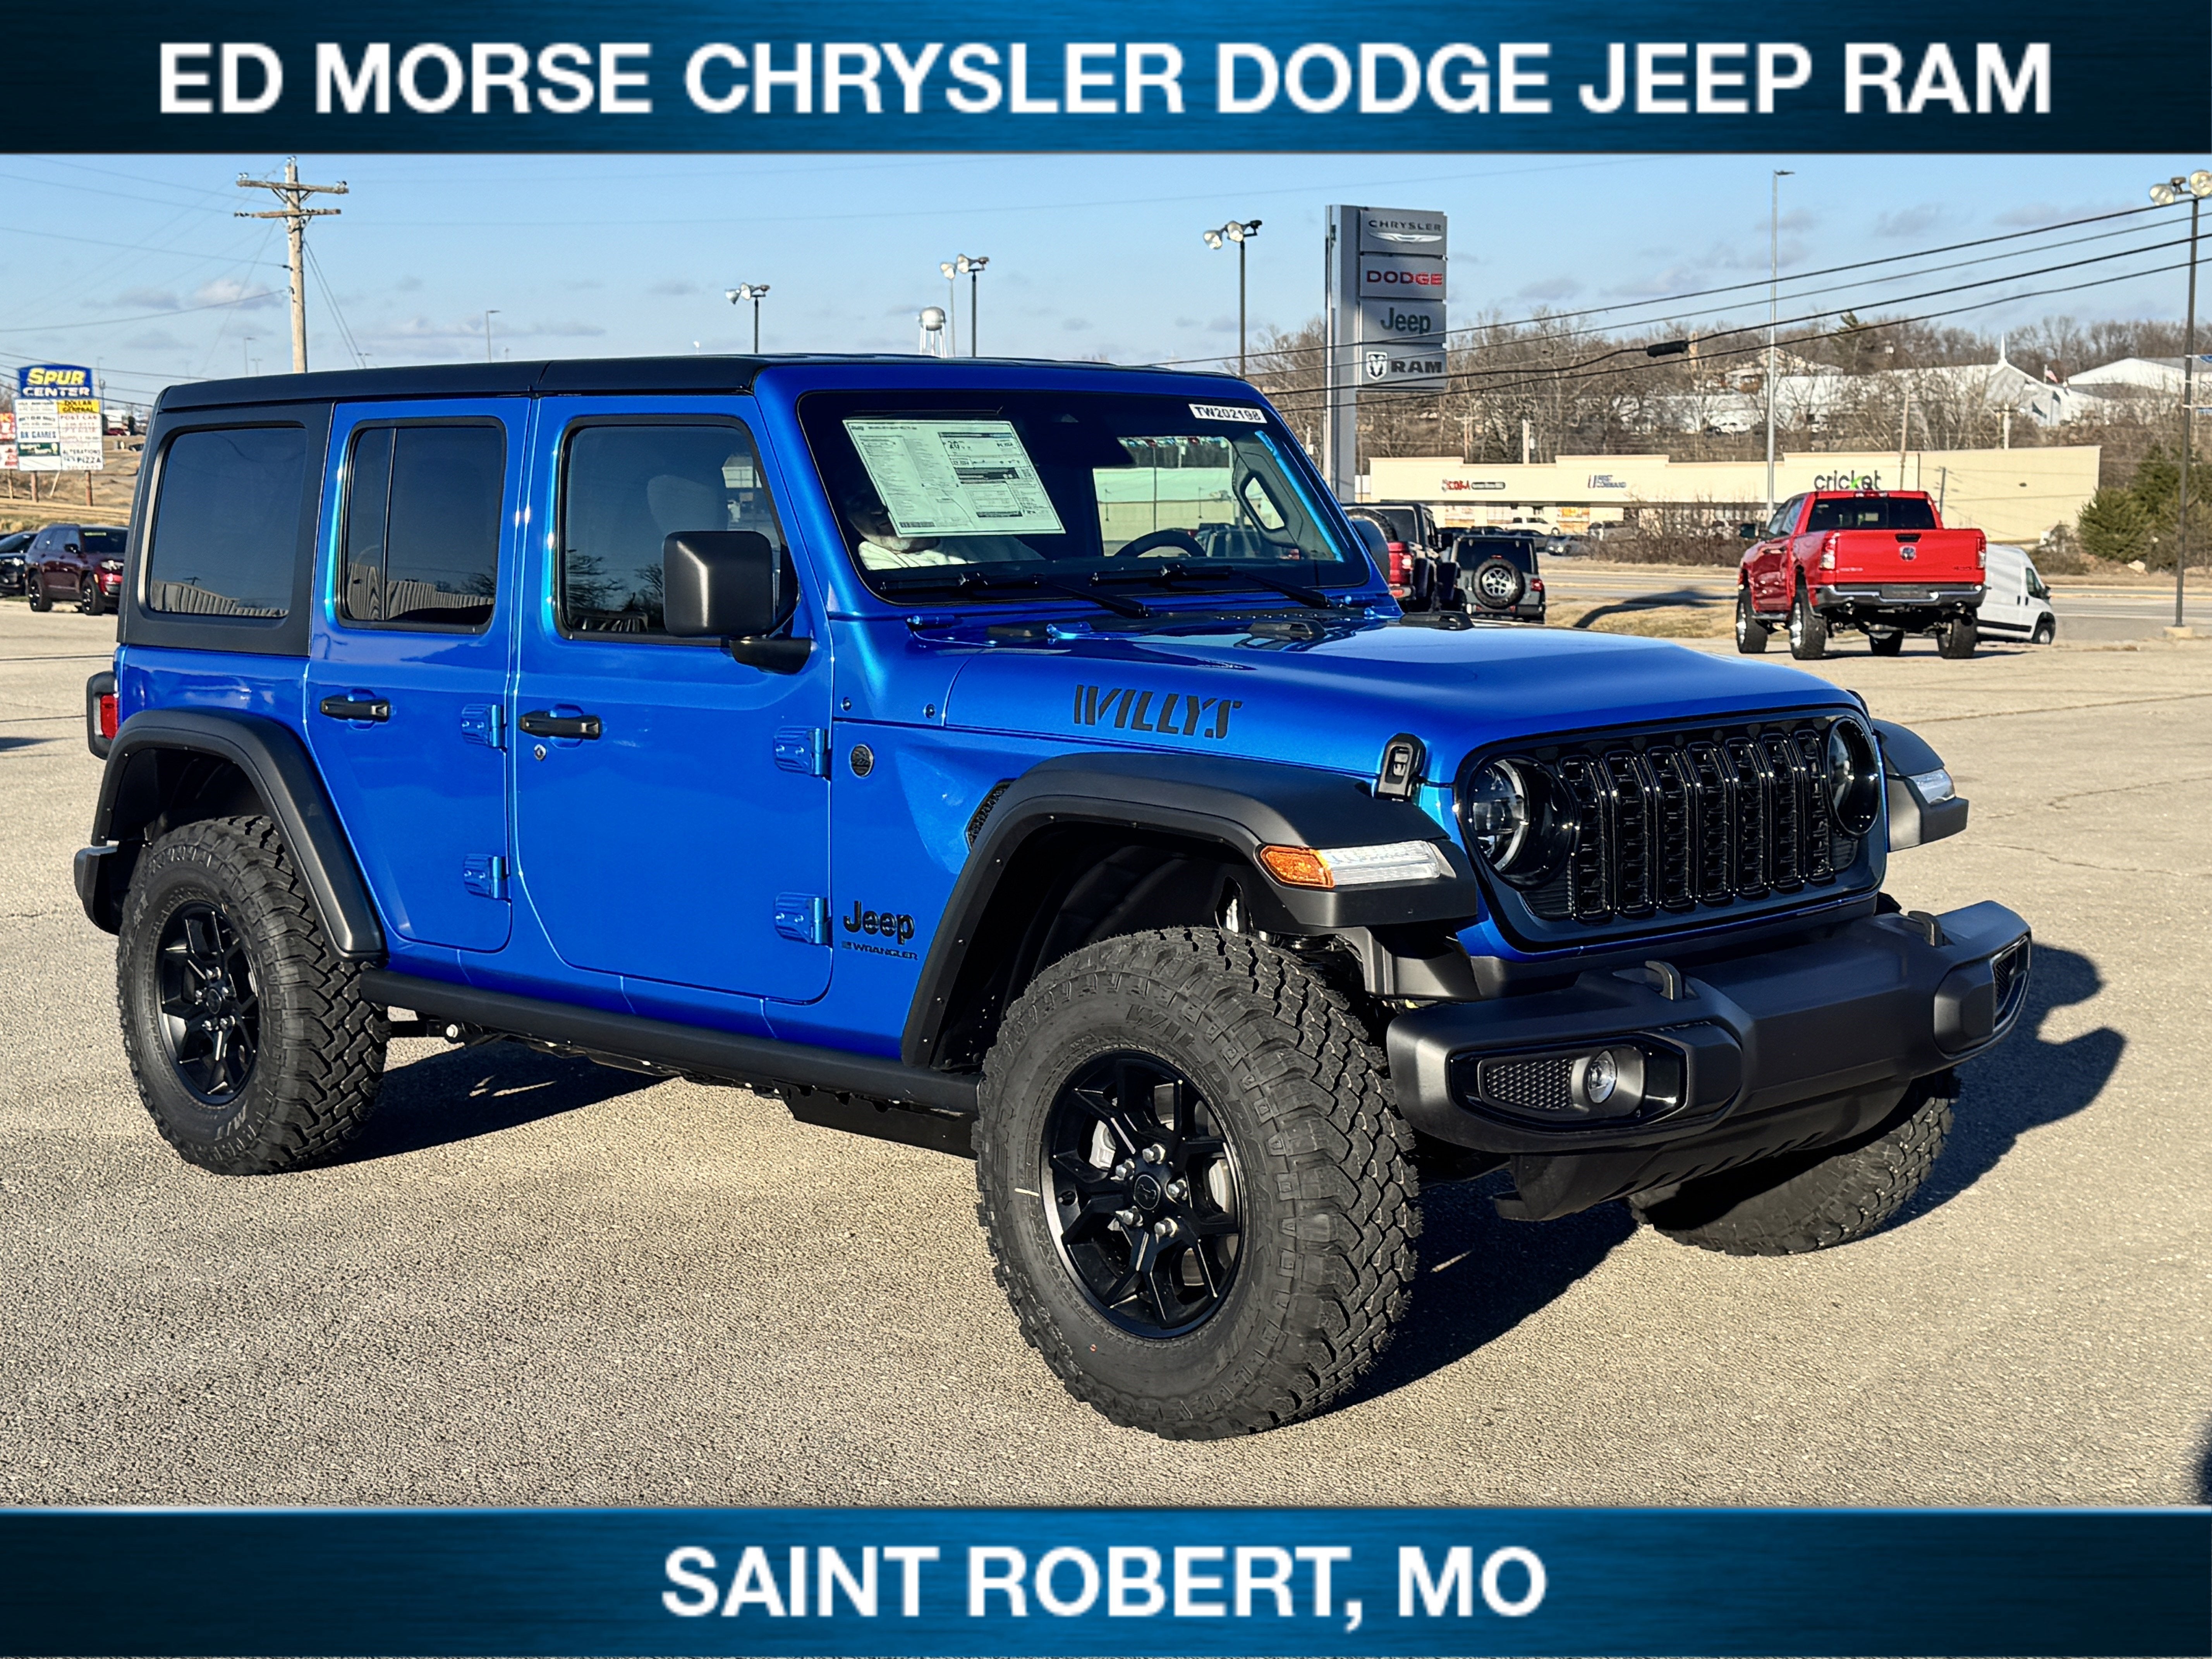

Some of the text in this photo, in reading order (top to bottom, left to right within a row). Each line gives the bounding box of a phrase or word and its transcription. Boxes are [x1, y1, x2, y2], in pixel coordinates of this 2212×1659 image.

[1368, 220, 1441, 231] CHRYSLER
[1367, 270, 1443, 285] DODGE
[1381, 307, 1431, 334] Jeep
[1391, 360, 1443, 373] RAM
[27, 368, 86, 385] SPUR
[22, 387, 90, 397] CENTER
[1194, 406, 1261, 421] TW202198
[1814, 470, 1882, 490] cricket
[1073, 684, 1243, 739] WILLYS
[843, 900, 915, 945] Jeep
[852, 941, 918, 961] WRANGLER
